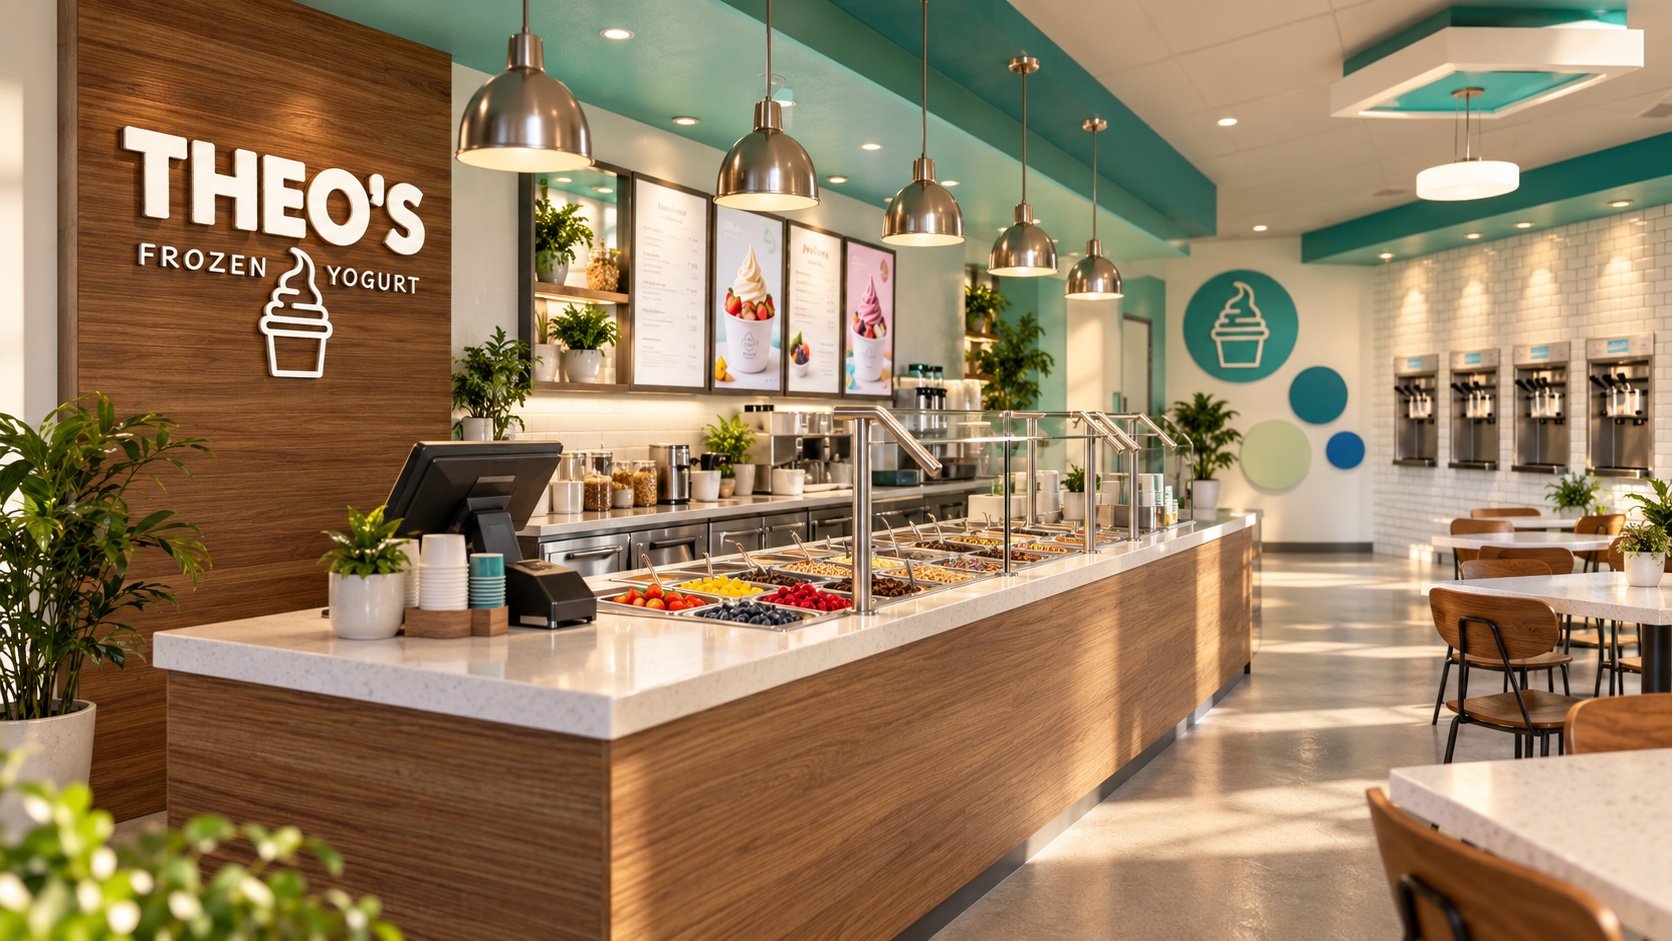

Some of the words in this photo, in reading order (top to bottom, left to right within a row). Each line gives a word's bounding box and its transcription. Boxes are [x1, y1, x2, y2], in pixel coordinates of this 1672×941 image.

[122, 125, 426, 255] THEO'S
[139, 242, 267, 278] FROZEN
[327, 264, 421, 295] YOGURT
